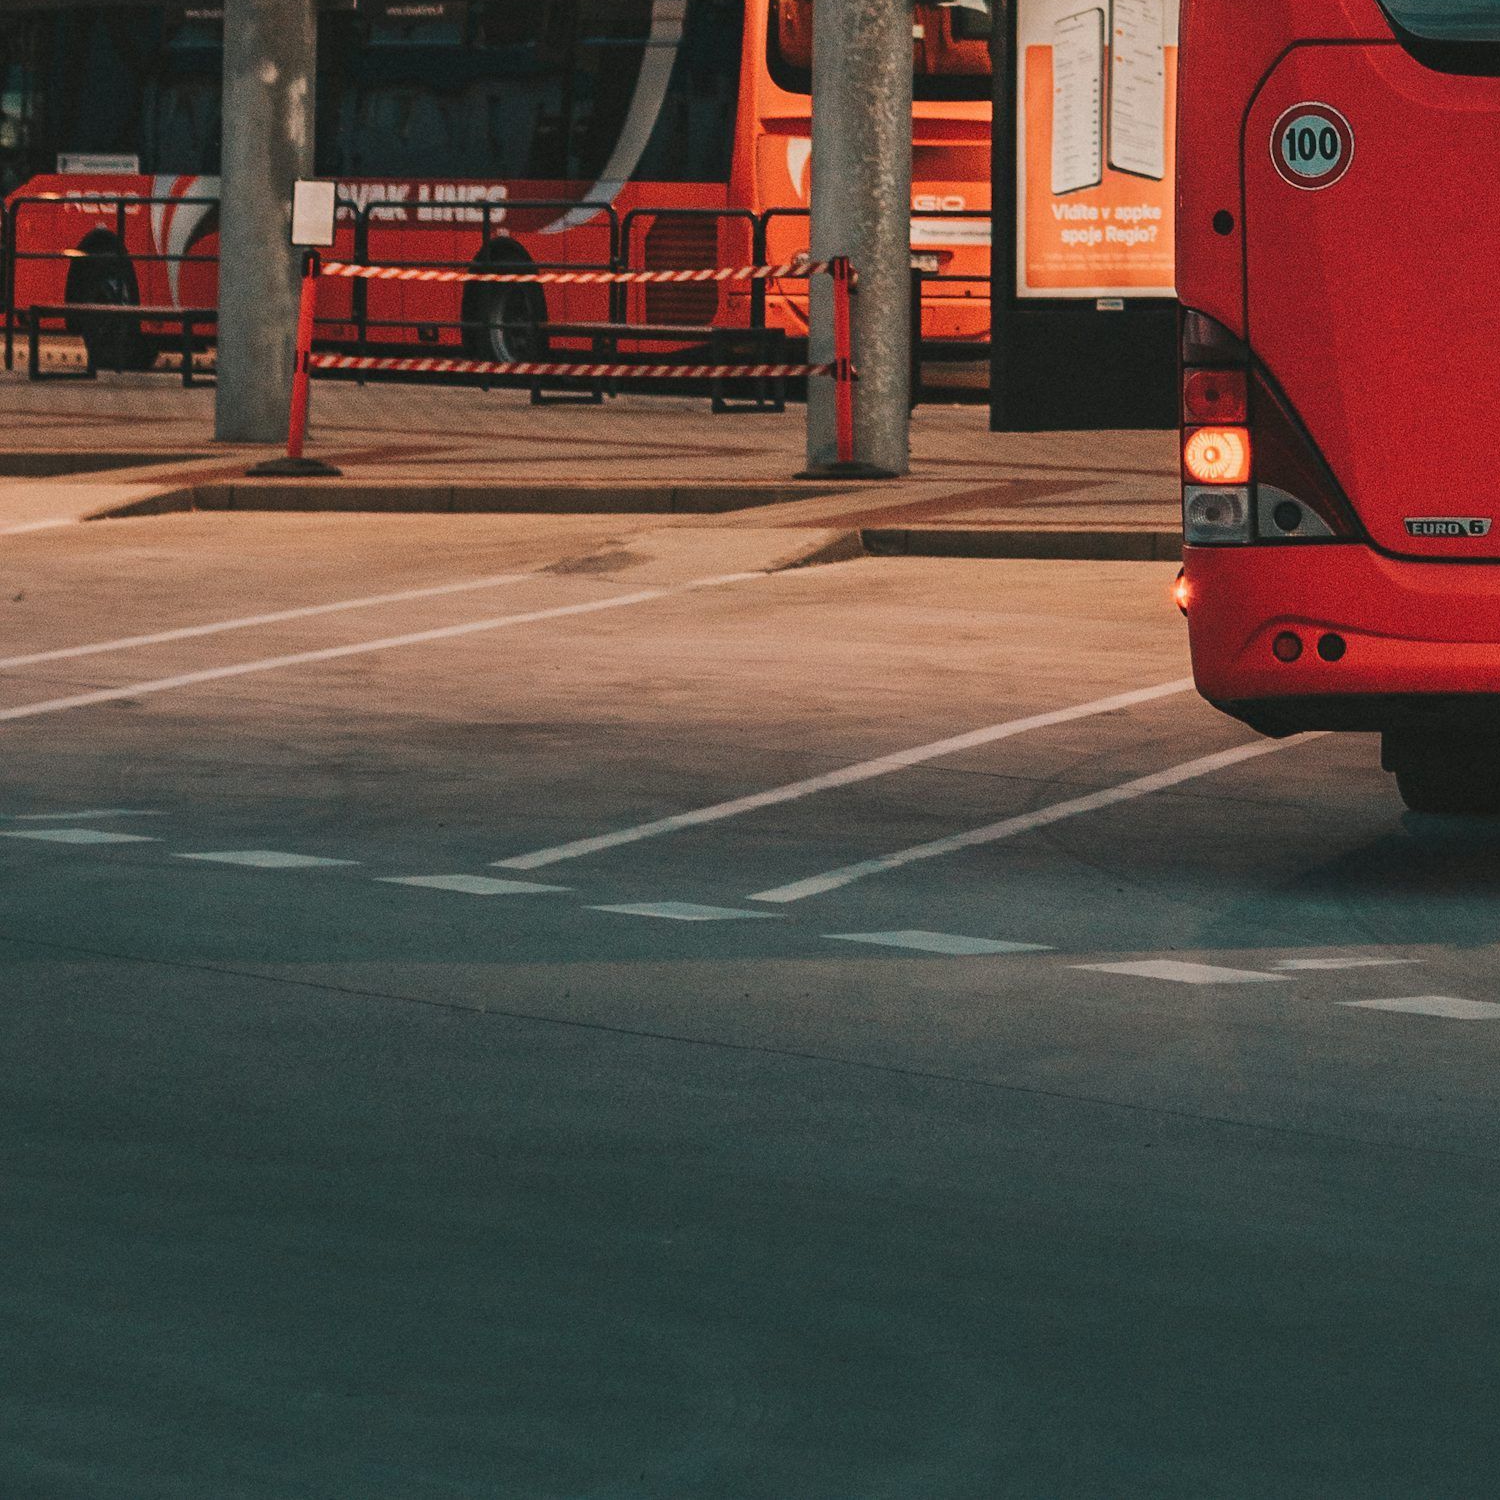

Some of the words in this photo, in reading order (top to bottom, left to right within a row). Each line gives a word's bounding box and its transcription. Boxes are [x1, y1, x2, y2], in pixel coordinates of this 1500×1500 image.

[1286, 127, 1338, 161] 100
[1101, 207, 1111, 219] v
[1061, 226, 1102, 247] spoje
[1105, 225, 1157, 247] Regio?
[1412, 522, 1460, 535] EURO
[1469, 520, 1484, 534] 6
